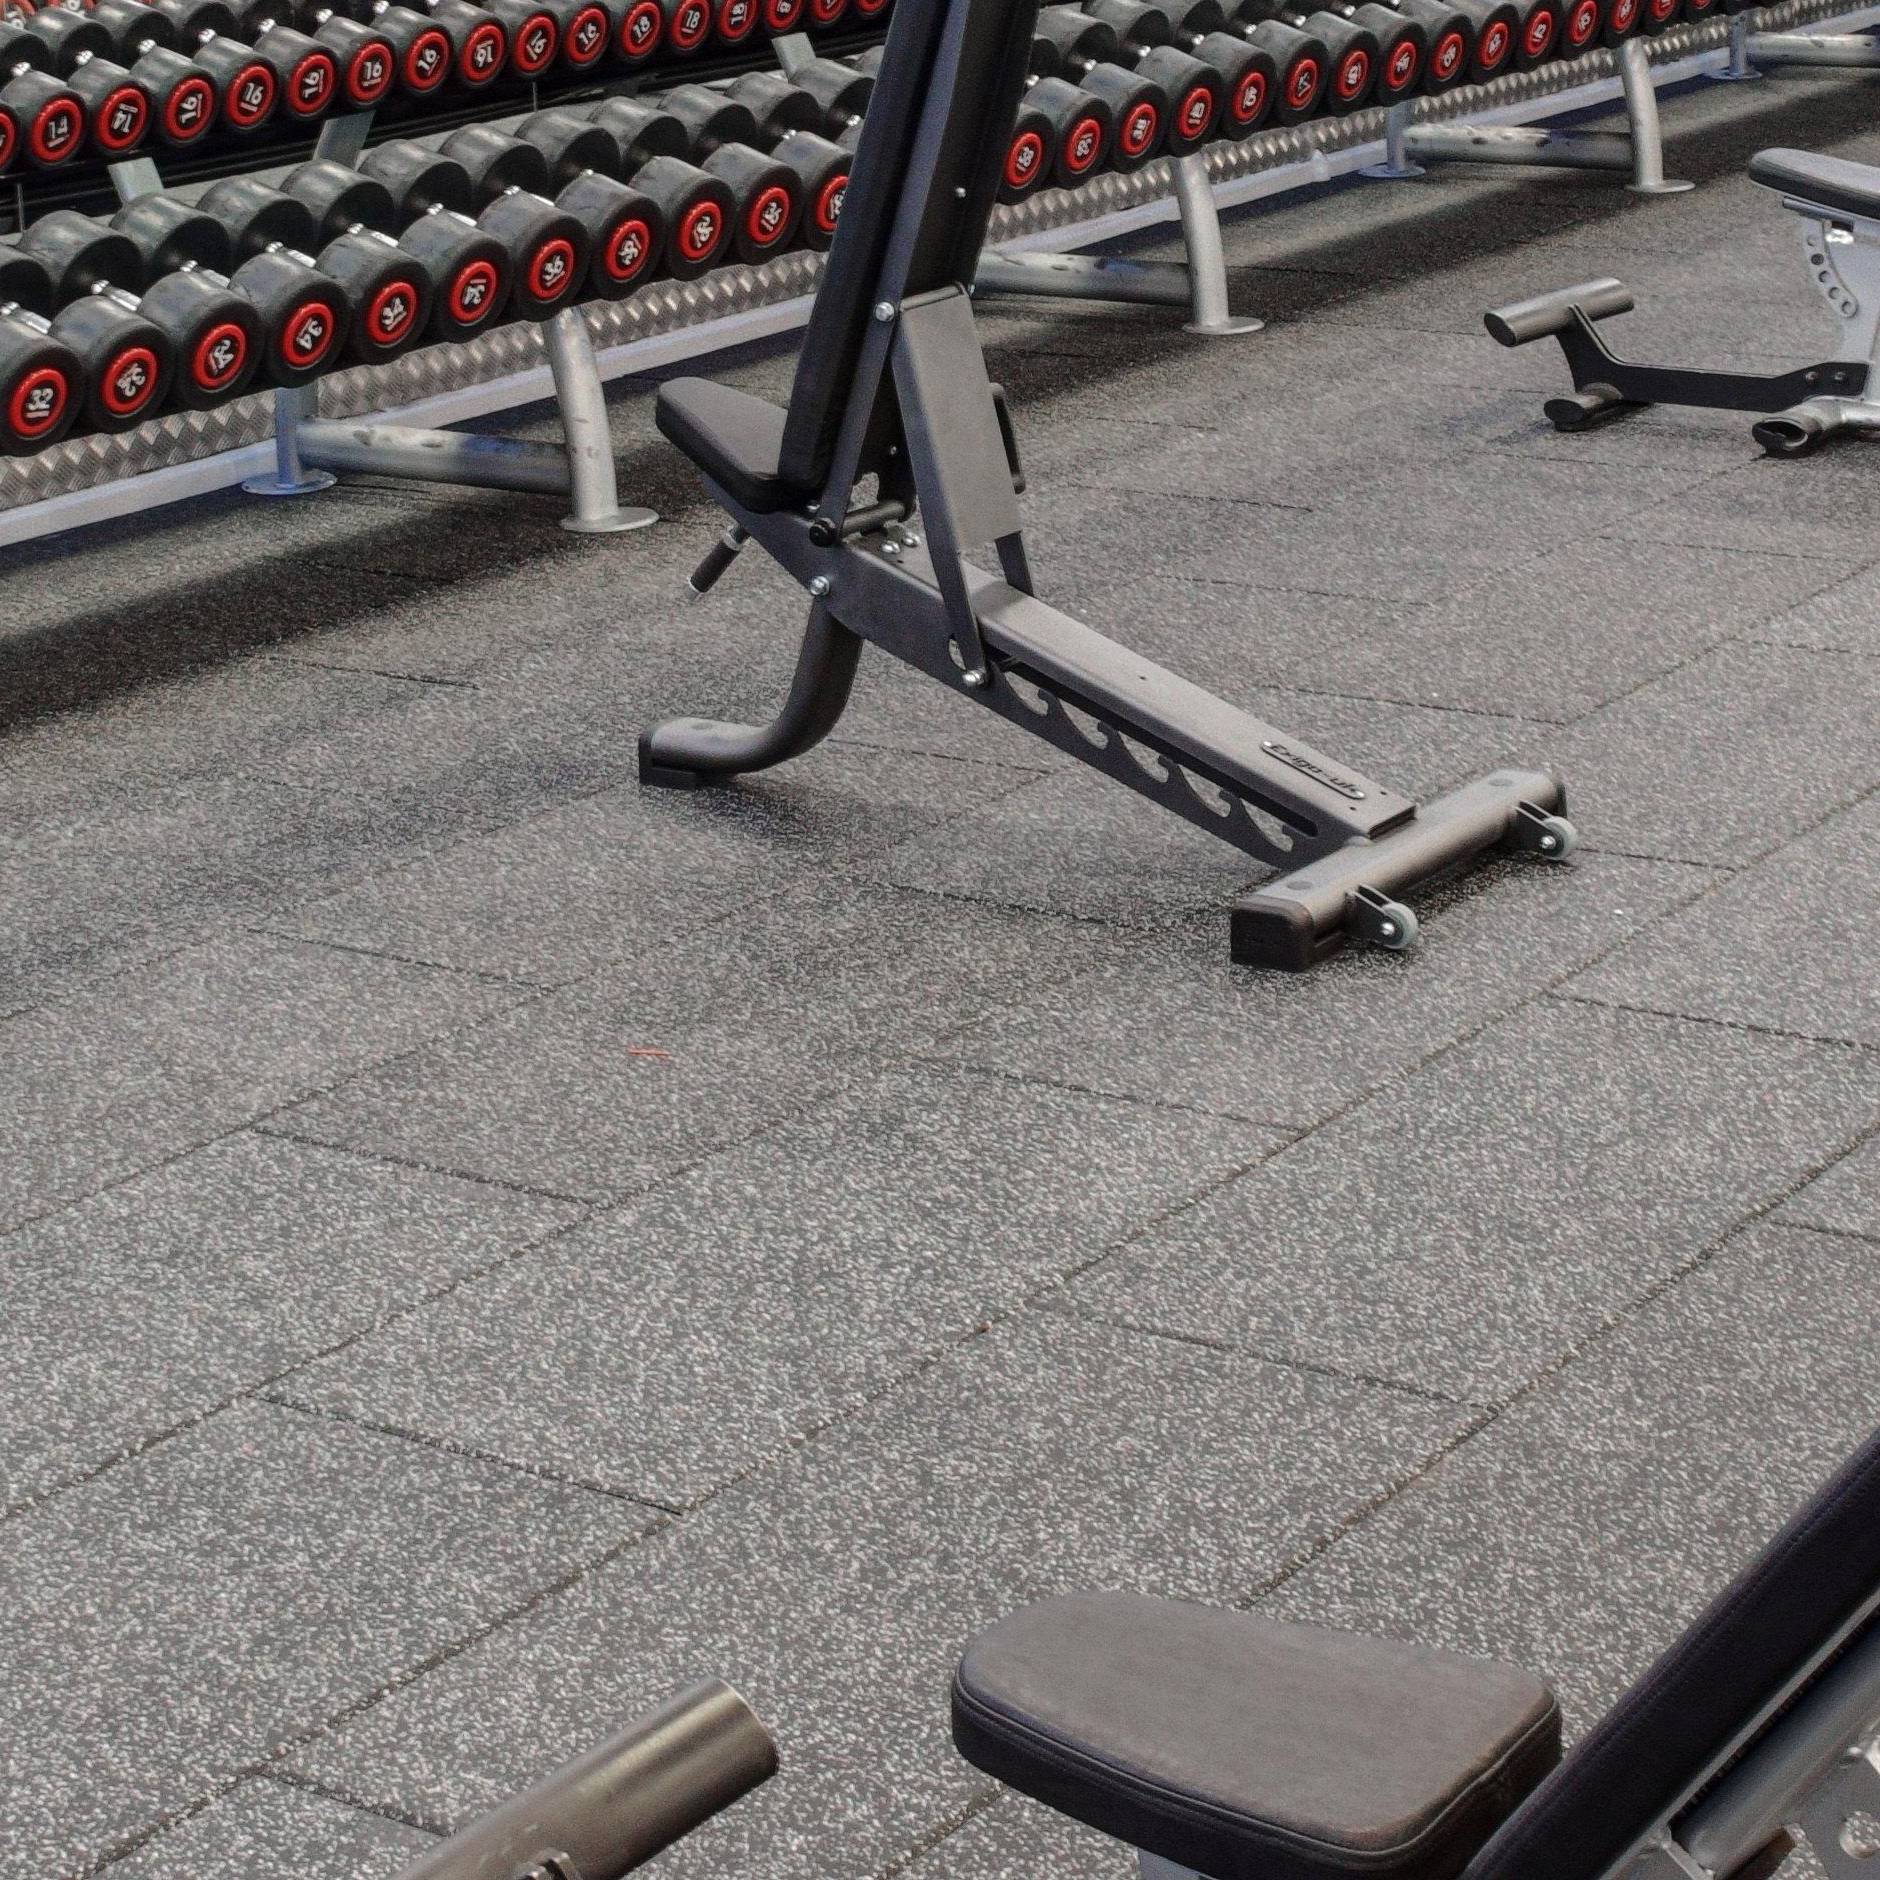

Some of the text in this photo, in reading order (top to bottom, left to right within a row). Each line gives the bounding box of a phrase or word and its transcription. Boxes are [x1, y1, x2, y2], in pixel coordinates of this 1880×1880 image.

[686, 10, 700, 29] 18
[417, 48, 437, 70] 16
[364, 61, 382, 80] 16
[244, 82, 264, 105] 16
[302, 72, 319, 98] 16
[181, 96, 198, 123] 16
